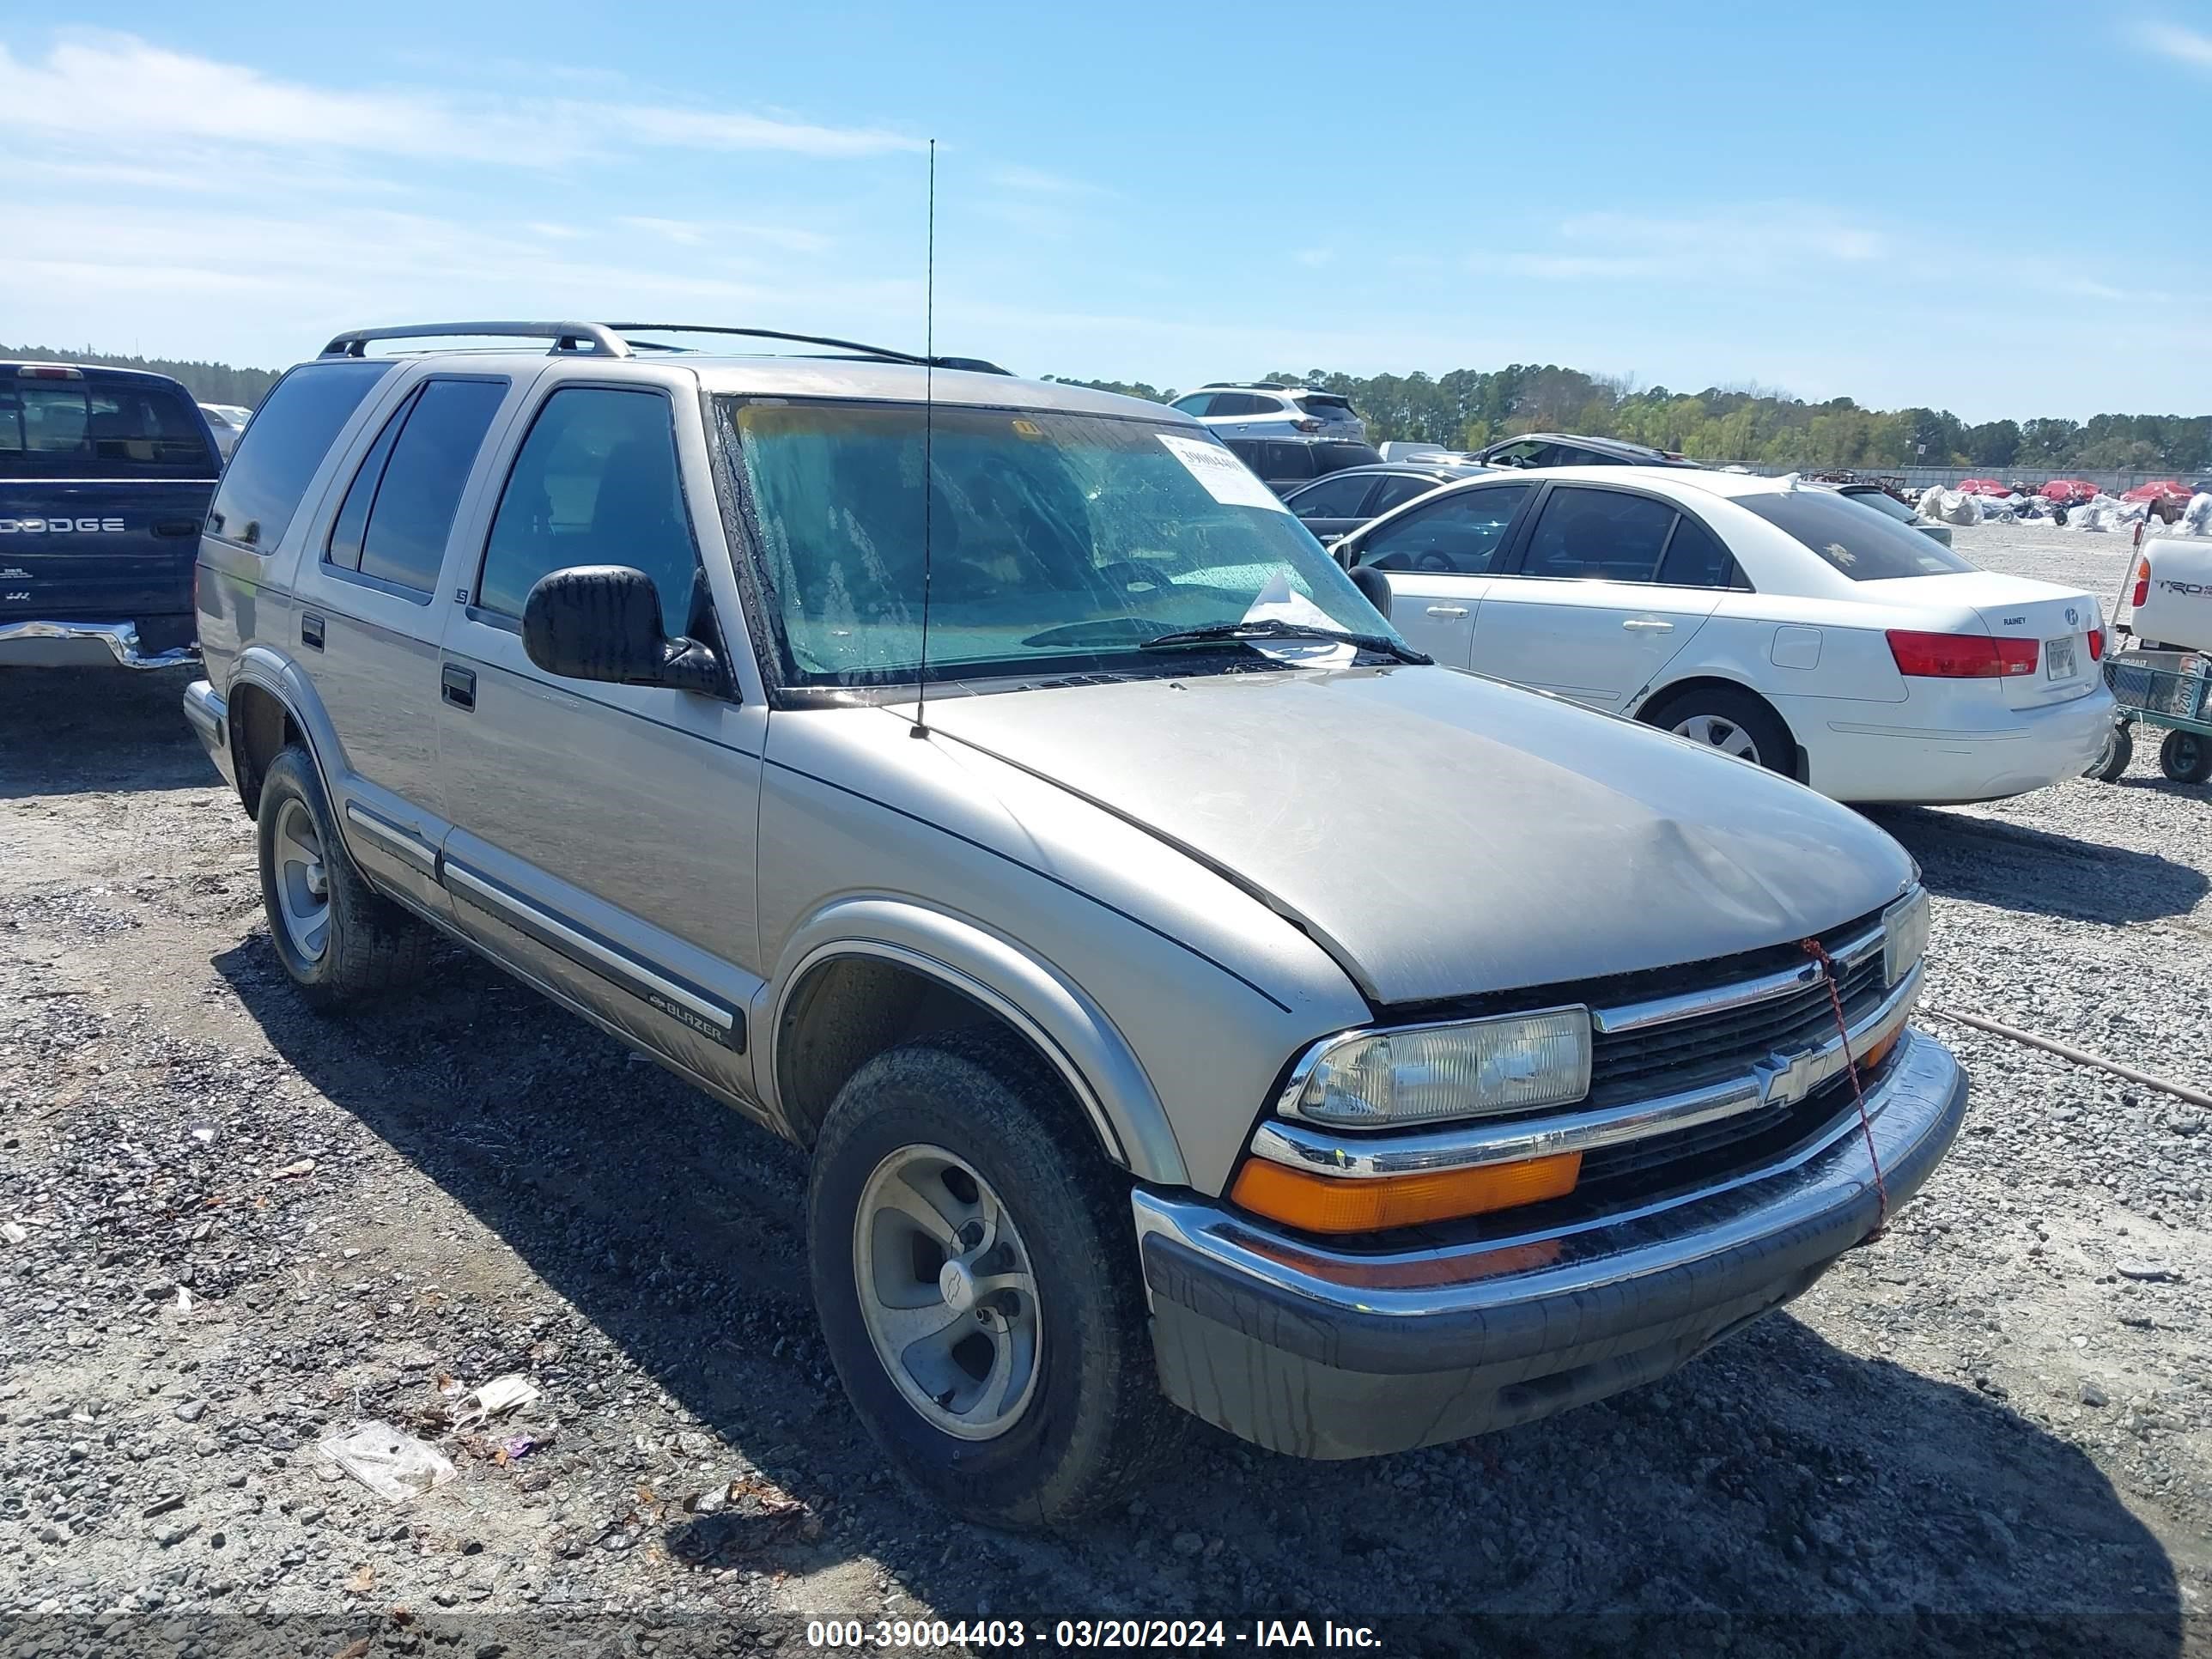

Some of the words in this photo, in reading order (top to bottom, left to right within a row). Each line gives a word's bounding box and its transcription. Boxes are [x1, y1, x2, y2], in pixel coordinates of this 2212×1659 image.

[0, 518, 125, 533] DODGE
[2003, 617, 2027, 626] RAINEY
[2119, 658, 2148, 667] KOBALT
[666, 1002, 722, 1041] BLAZER
